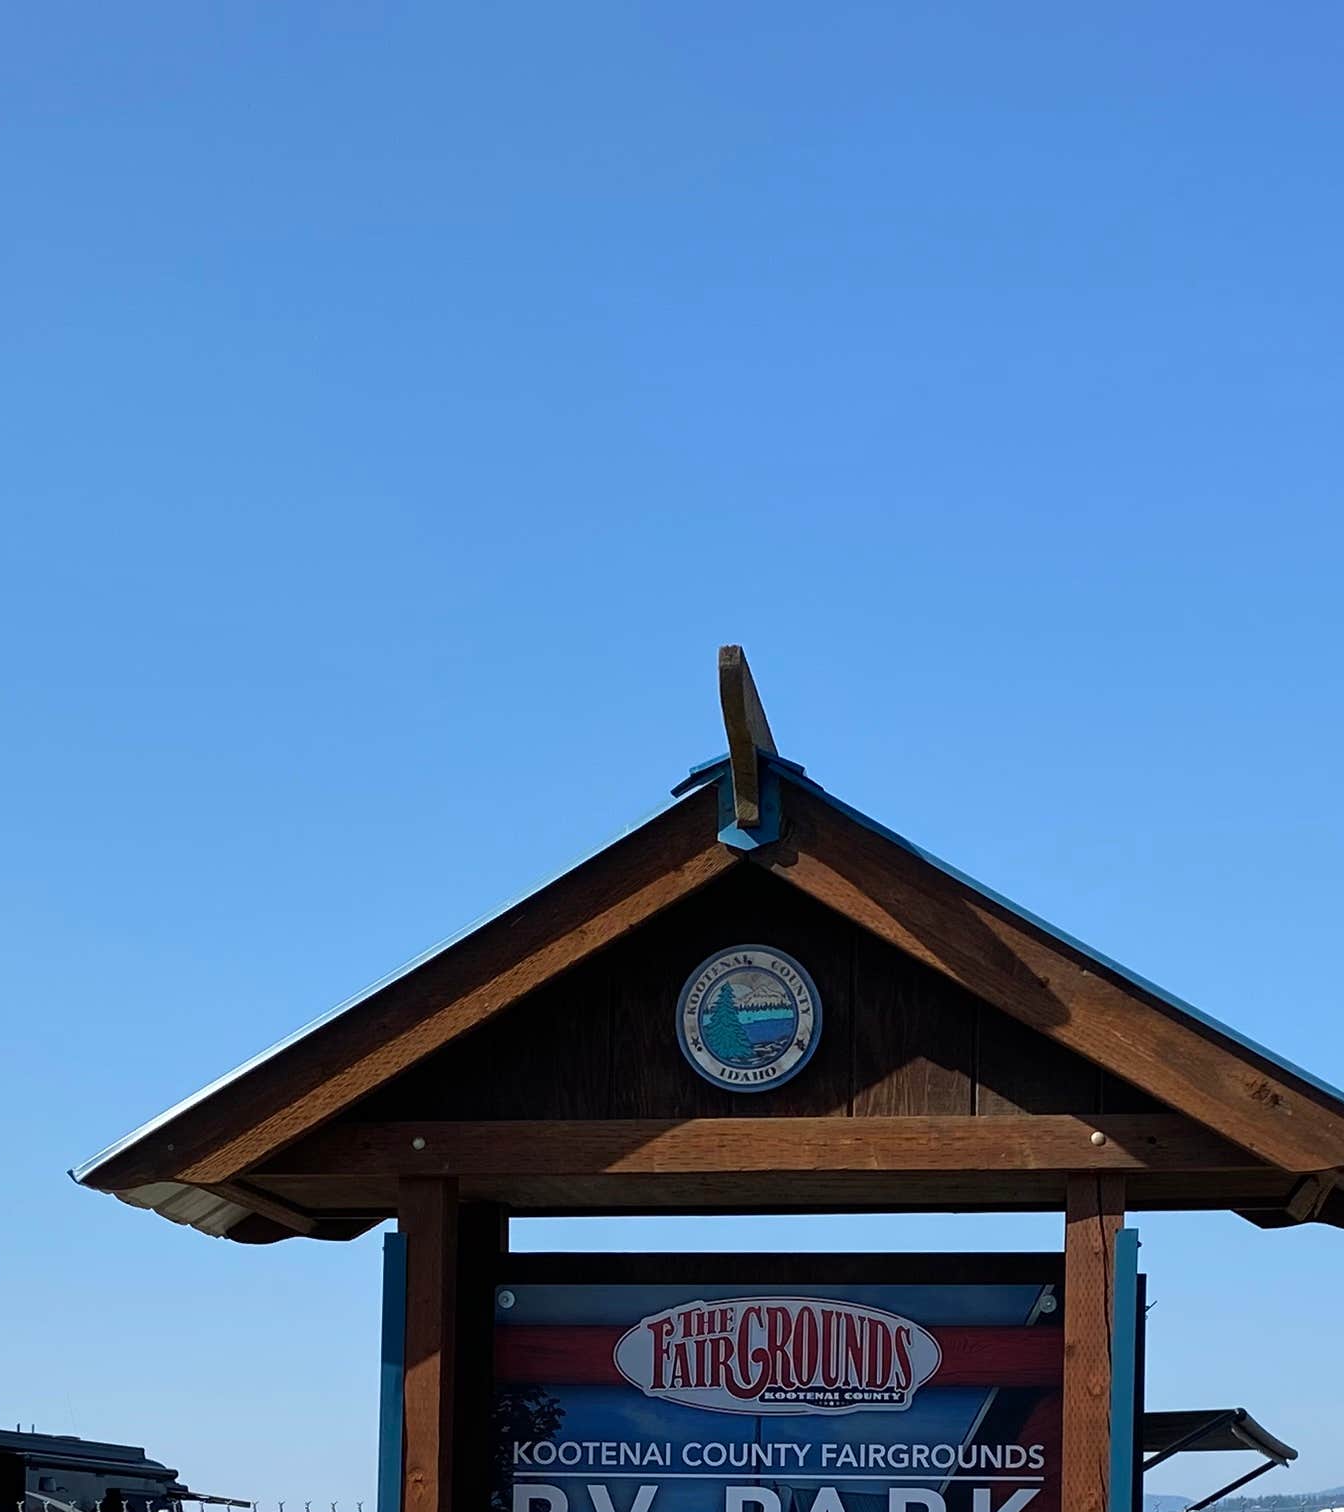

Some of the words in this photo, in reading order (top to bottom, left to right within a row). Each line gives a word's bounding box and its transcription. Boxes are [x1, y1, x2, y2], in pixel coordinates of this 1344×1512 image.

[771, 960, 811, 1017] COUNTY
[719, 1066, 777, 1082] IDAHO
[677, 1307, 736, 1339] THE
[764, 1391, 840, 1400] KOOTENAI
[844, 1391, 901, 1401] COUNTY
[512, 1440, 672, 1467] KOOTENAI
[681, 1441, 812, 1468] COUNTY
[820, 1442, 1045, 1470] FAIRGROUNDS
